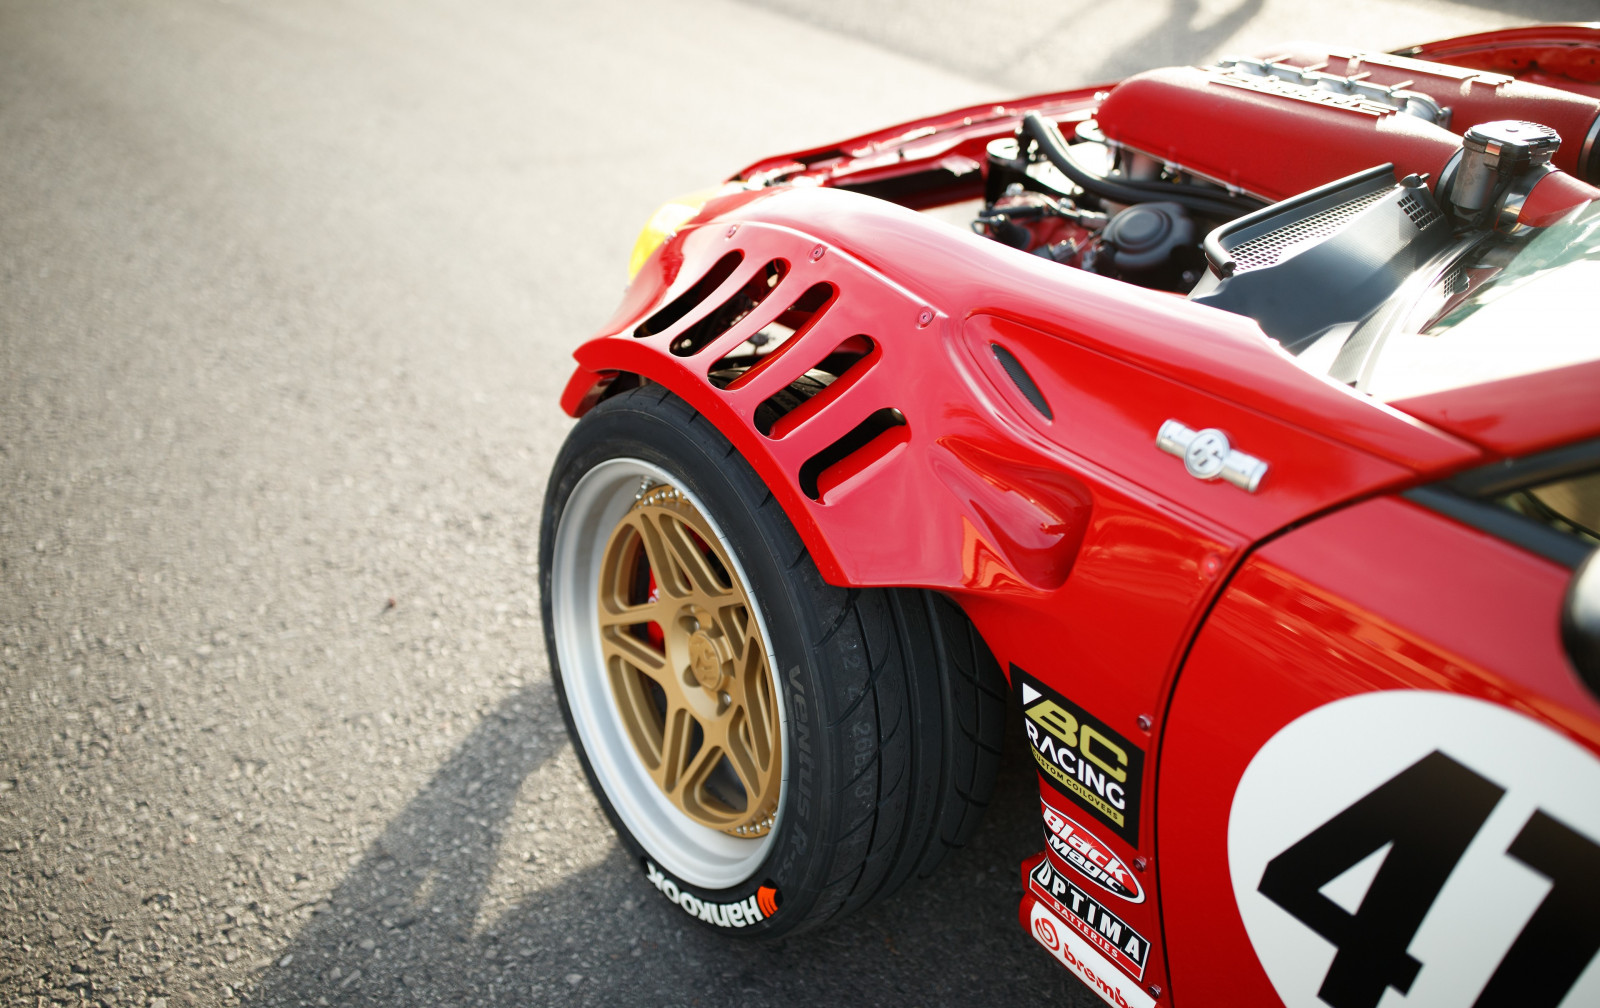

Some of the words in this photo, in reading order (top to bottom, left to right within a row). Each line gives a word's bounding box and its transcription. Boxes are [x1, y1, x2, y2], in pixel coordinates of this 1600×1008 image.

[1024, 699, 1129, 783] BC
[1025, 717, 1126, 810] RACING
[1032, 749, 1065, 782] CUSTOM
[1066, 779, 1119, 820] COILOVERS
[1043, 808, 1130, 884] Black
[1048, 834, 1123, 892] Magic
[646, 861, 764, 928] Hankook
[1036, 862, 1141, 962] OPTIMA
[1053, 901, 1118, 958] BATTERIES
[1063, 942, 1135, 1008] bremb
